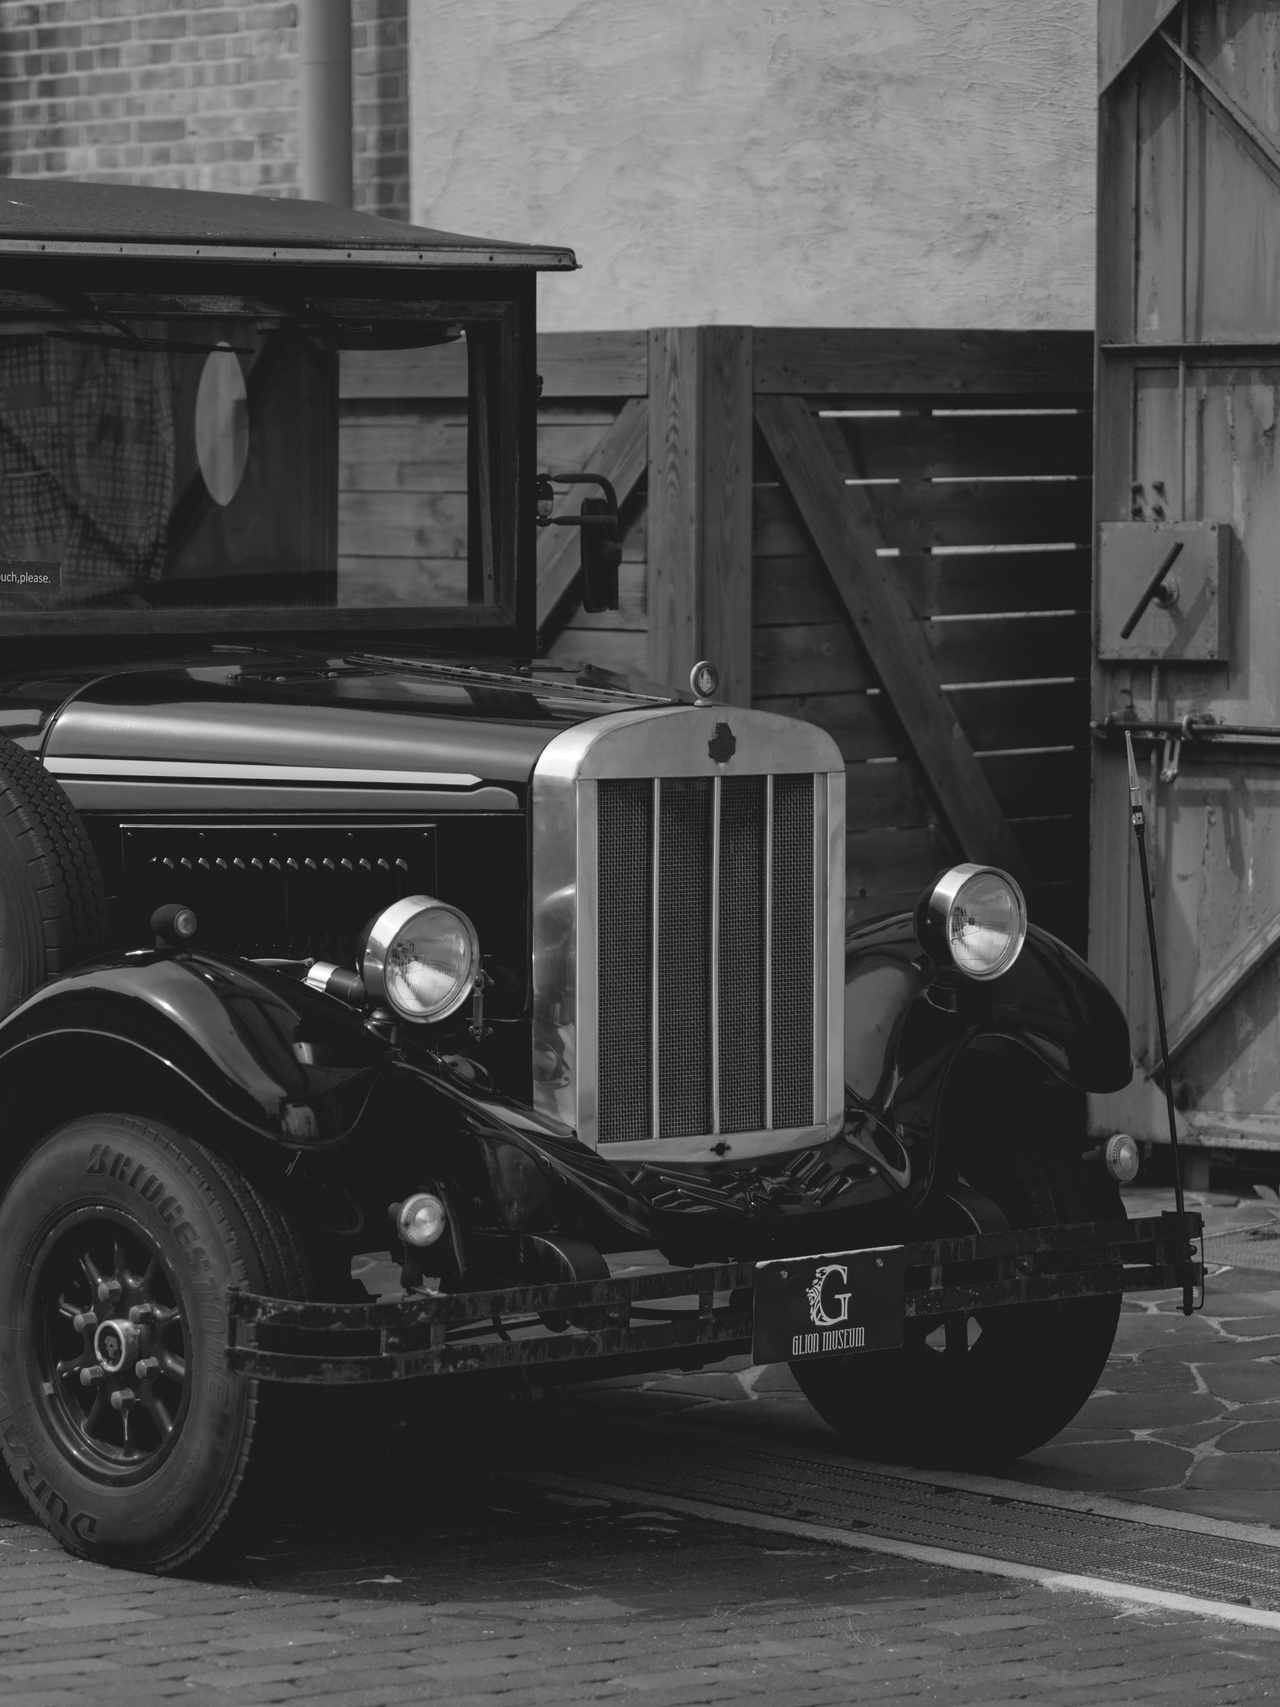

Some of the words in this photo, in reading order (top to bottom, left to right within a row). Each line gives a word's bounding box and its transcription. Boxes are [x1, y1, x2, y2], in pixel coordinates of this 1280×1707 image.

[84, 1143, 229, 1405] BRIDGESTONE
[792, 1332, 820, 1356] GLION
[821, 1326, 866, 1352] MUSEUM
